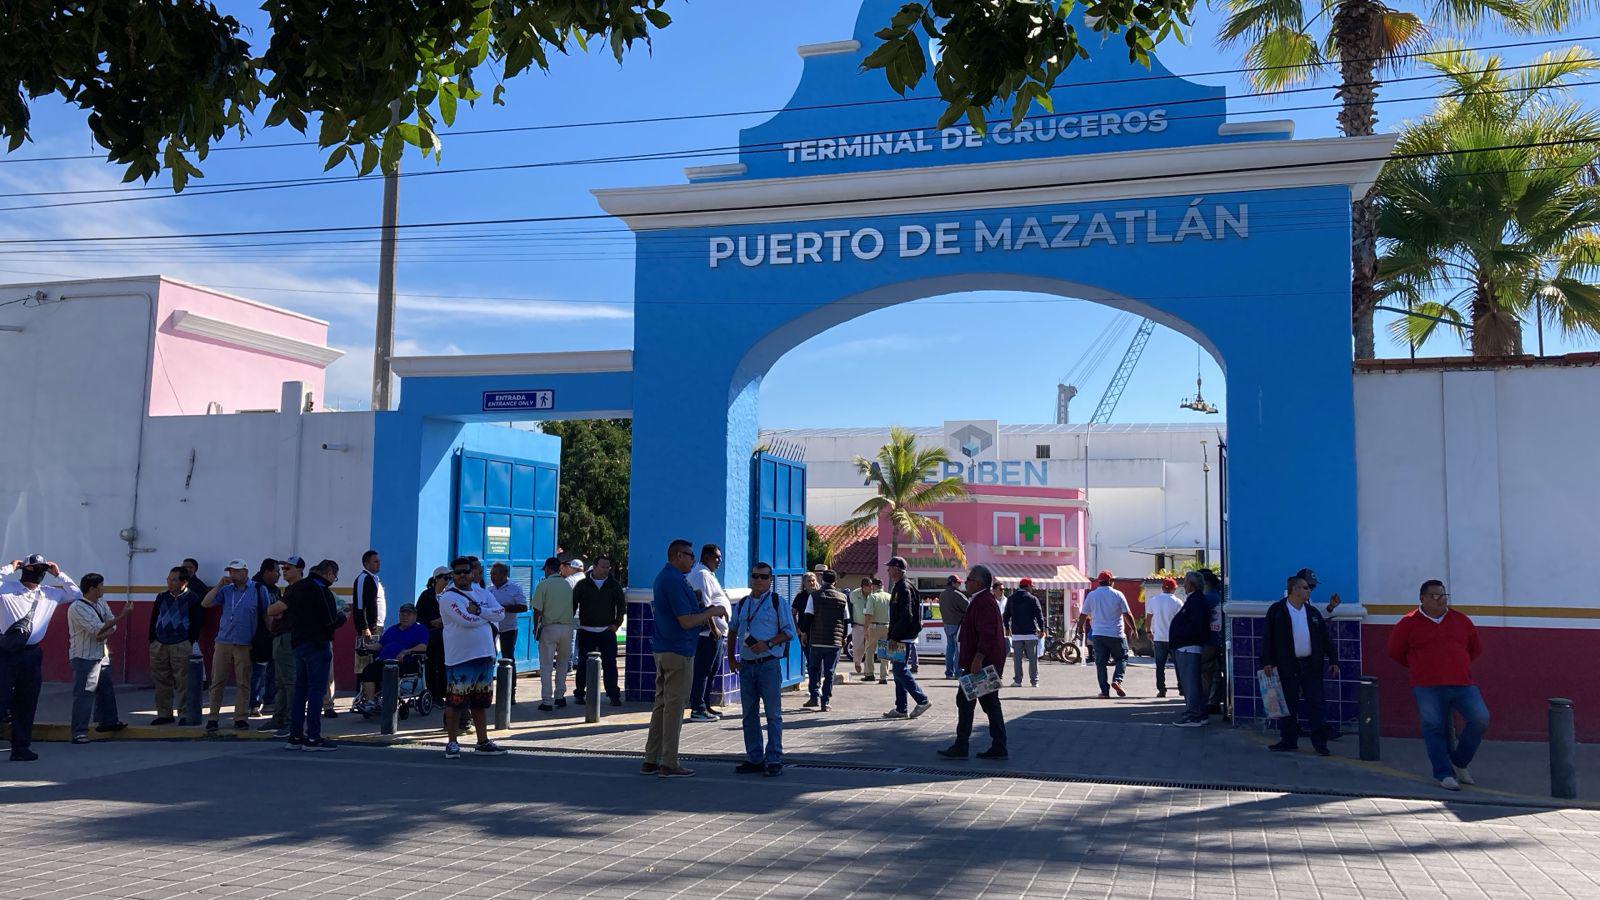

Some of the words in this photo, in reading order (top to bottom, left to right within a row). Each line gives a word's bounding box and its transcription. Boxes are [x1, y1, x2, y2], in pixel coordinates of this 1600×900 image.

[783, 130, 933, 163] TERMINAL
[942, 124, 983, 150] DE
[992, 109, 1169, 145] CRUCEROS
[709, 227, 884, 268] PUERTO
[900, 222, 961, 258] DE
[975, 198, 1249, 252] MAZATLÁN
[863, 460, 1048, 486] AERIBEN
